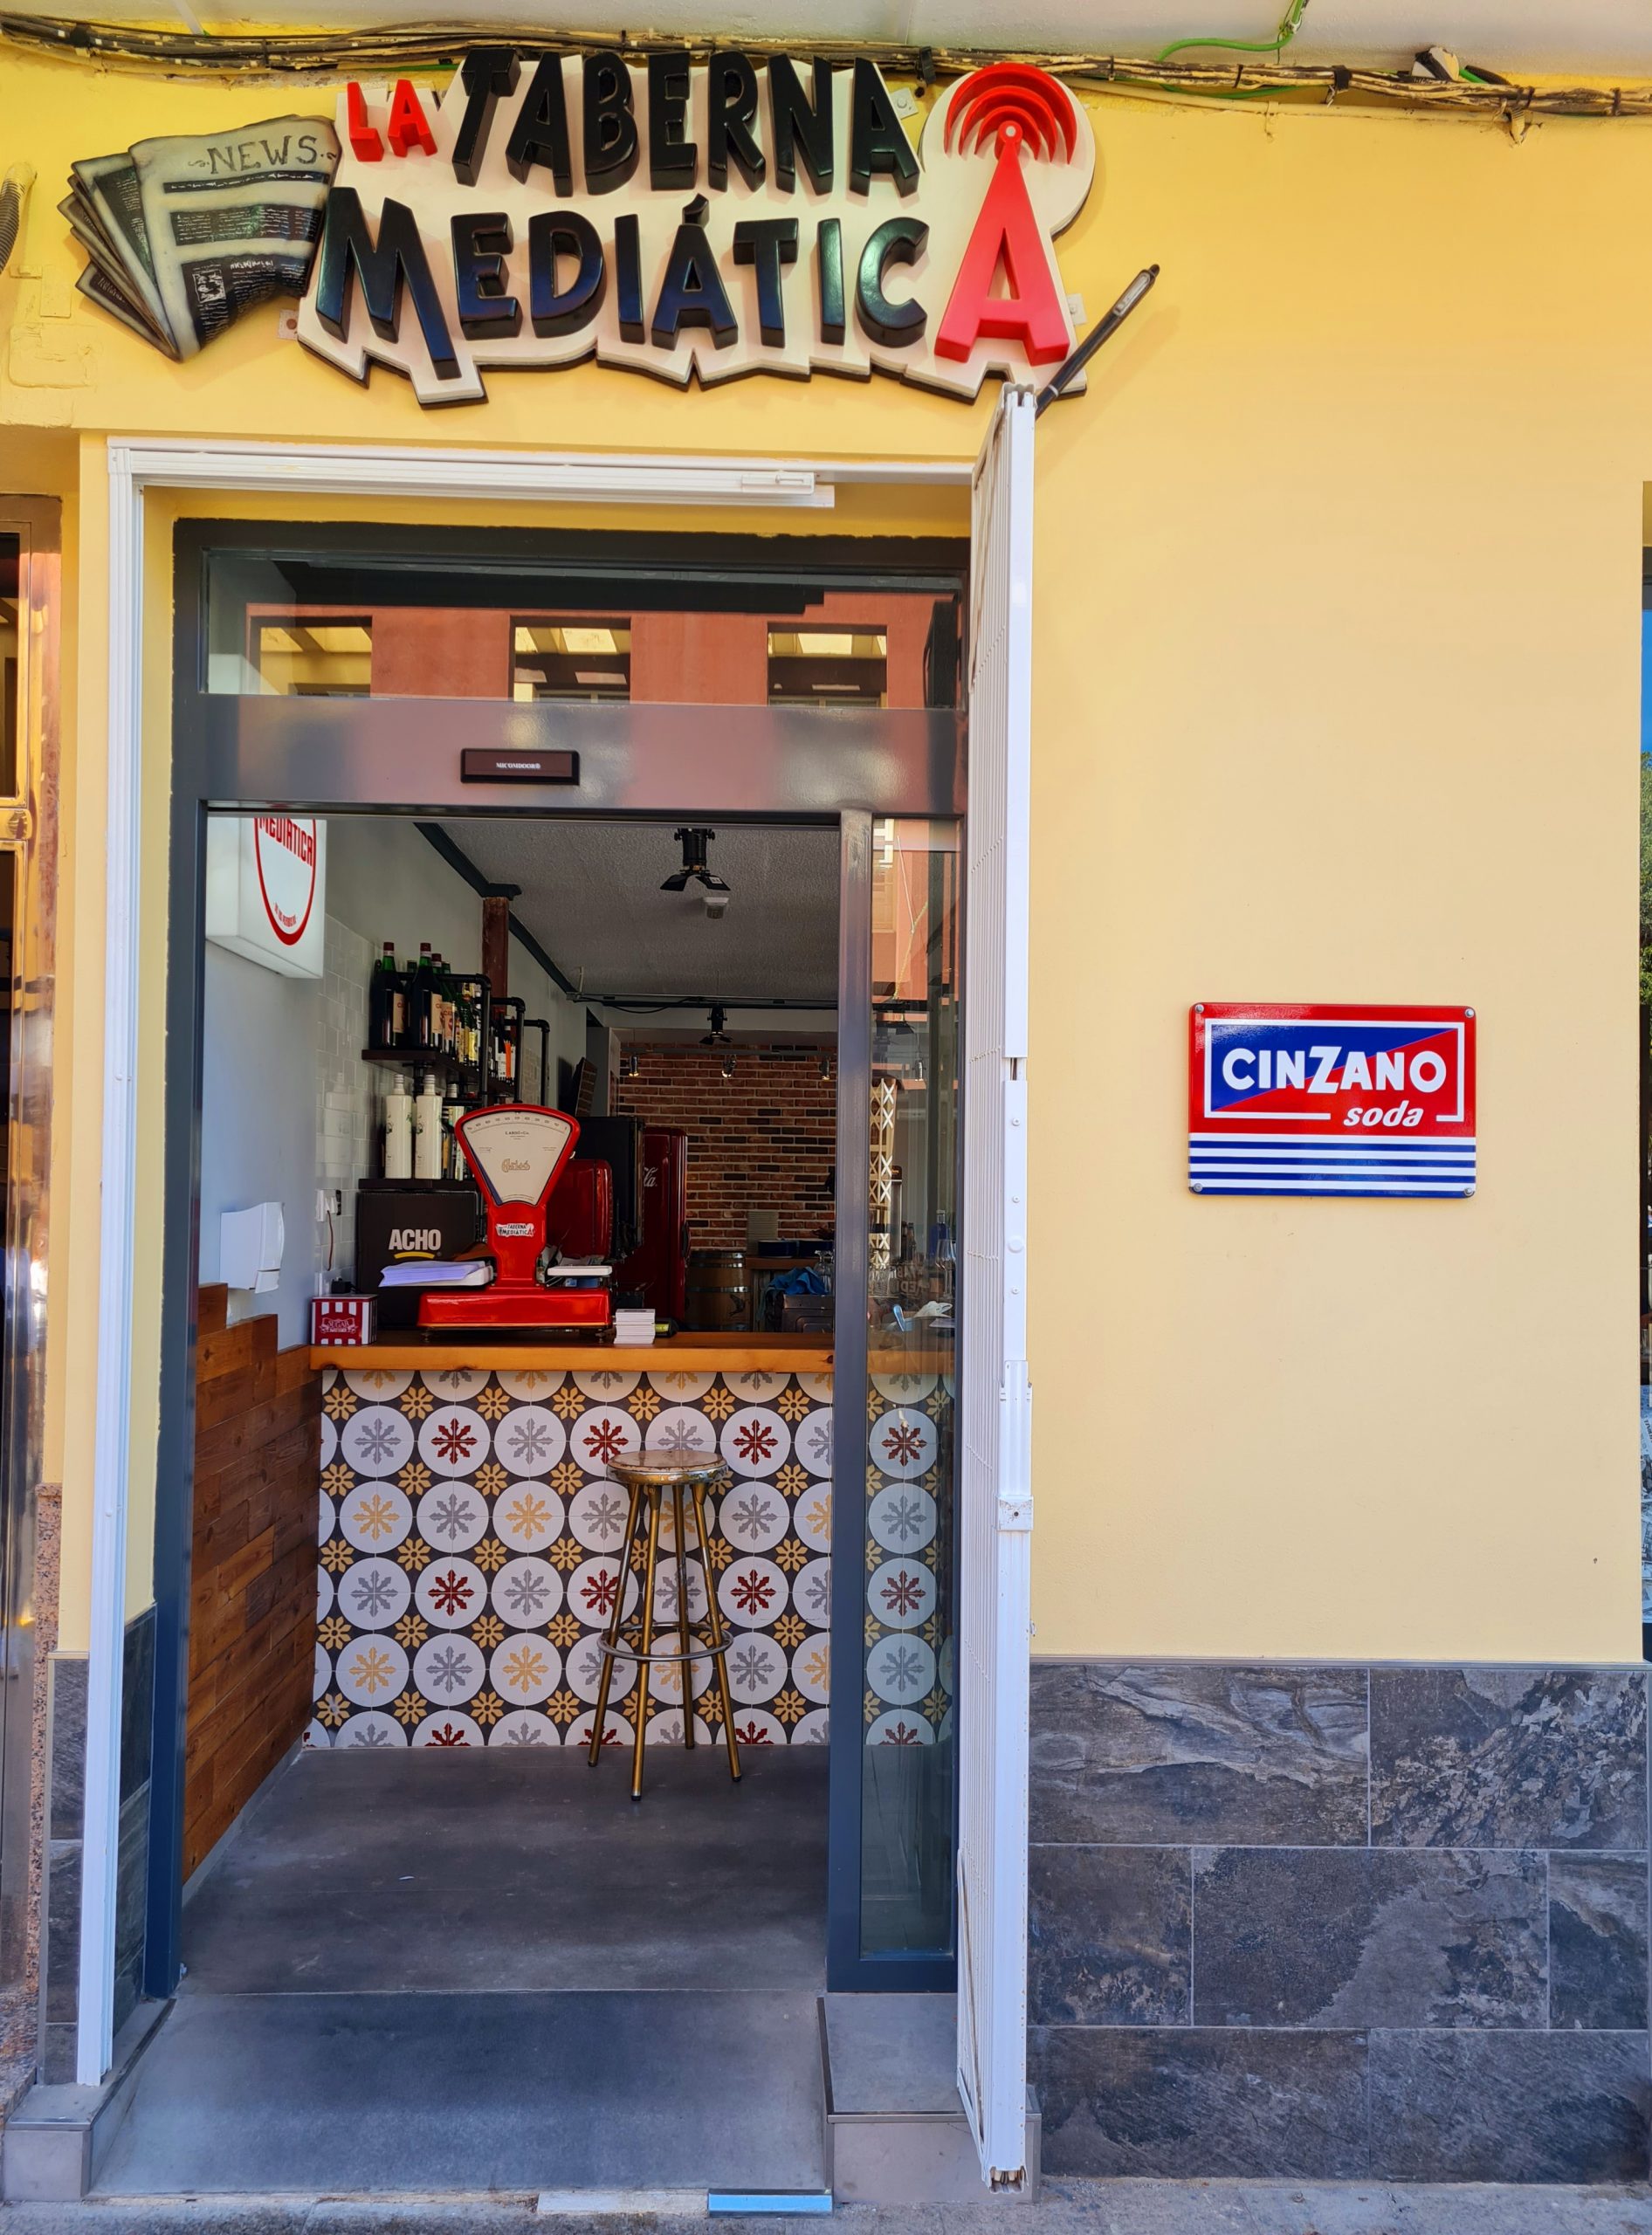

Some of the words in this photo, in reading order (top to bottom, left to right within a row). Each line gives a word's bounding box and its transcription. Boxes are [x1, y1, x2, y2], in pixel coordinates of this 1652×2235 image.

[347, 79, 437, 162] LA
[451, 48, 920, 198] TABERNA
[207, 135, 318, 175] NEWS
[316, 144, 1070, 381] MEDIÁTICA
[1222, 1046, 1447, 1094] CINZANO
[1343, 1100, 1424, 1127] soda
[389, 1229, 442, 1250] ACHO
